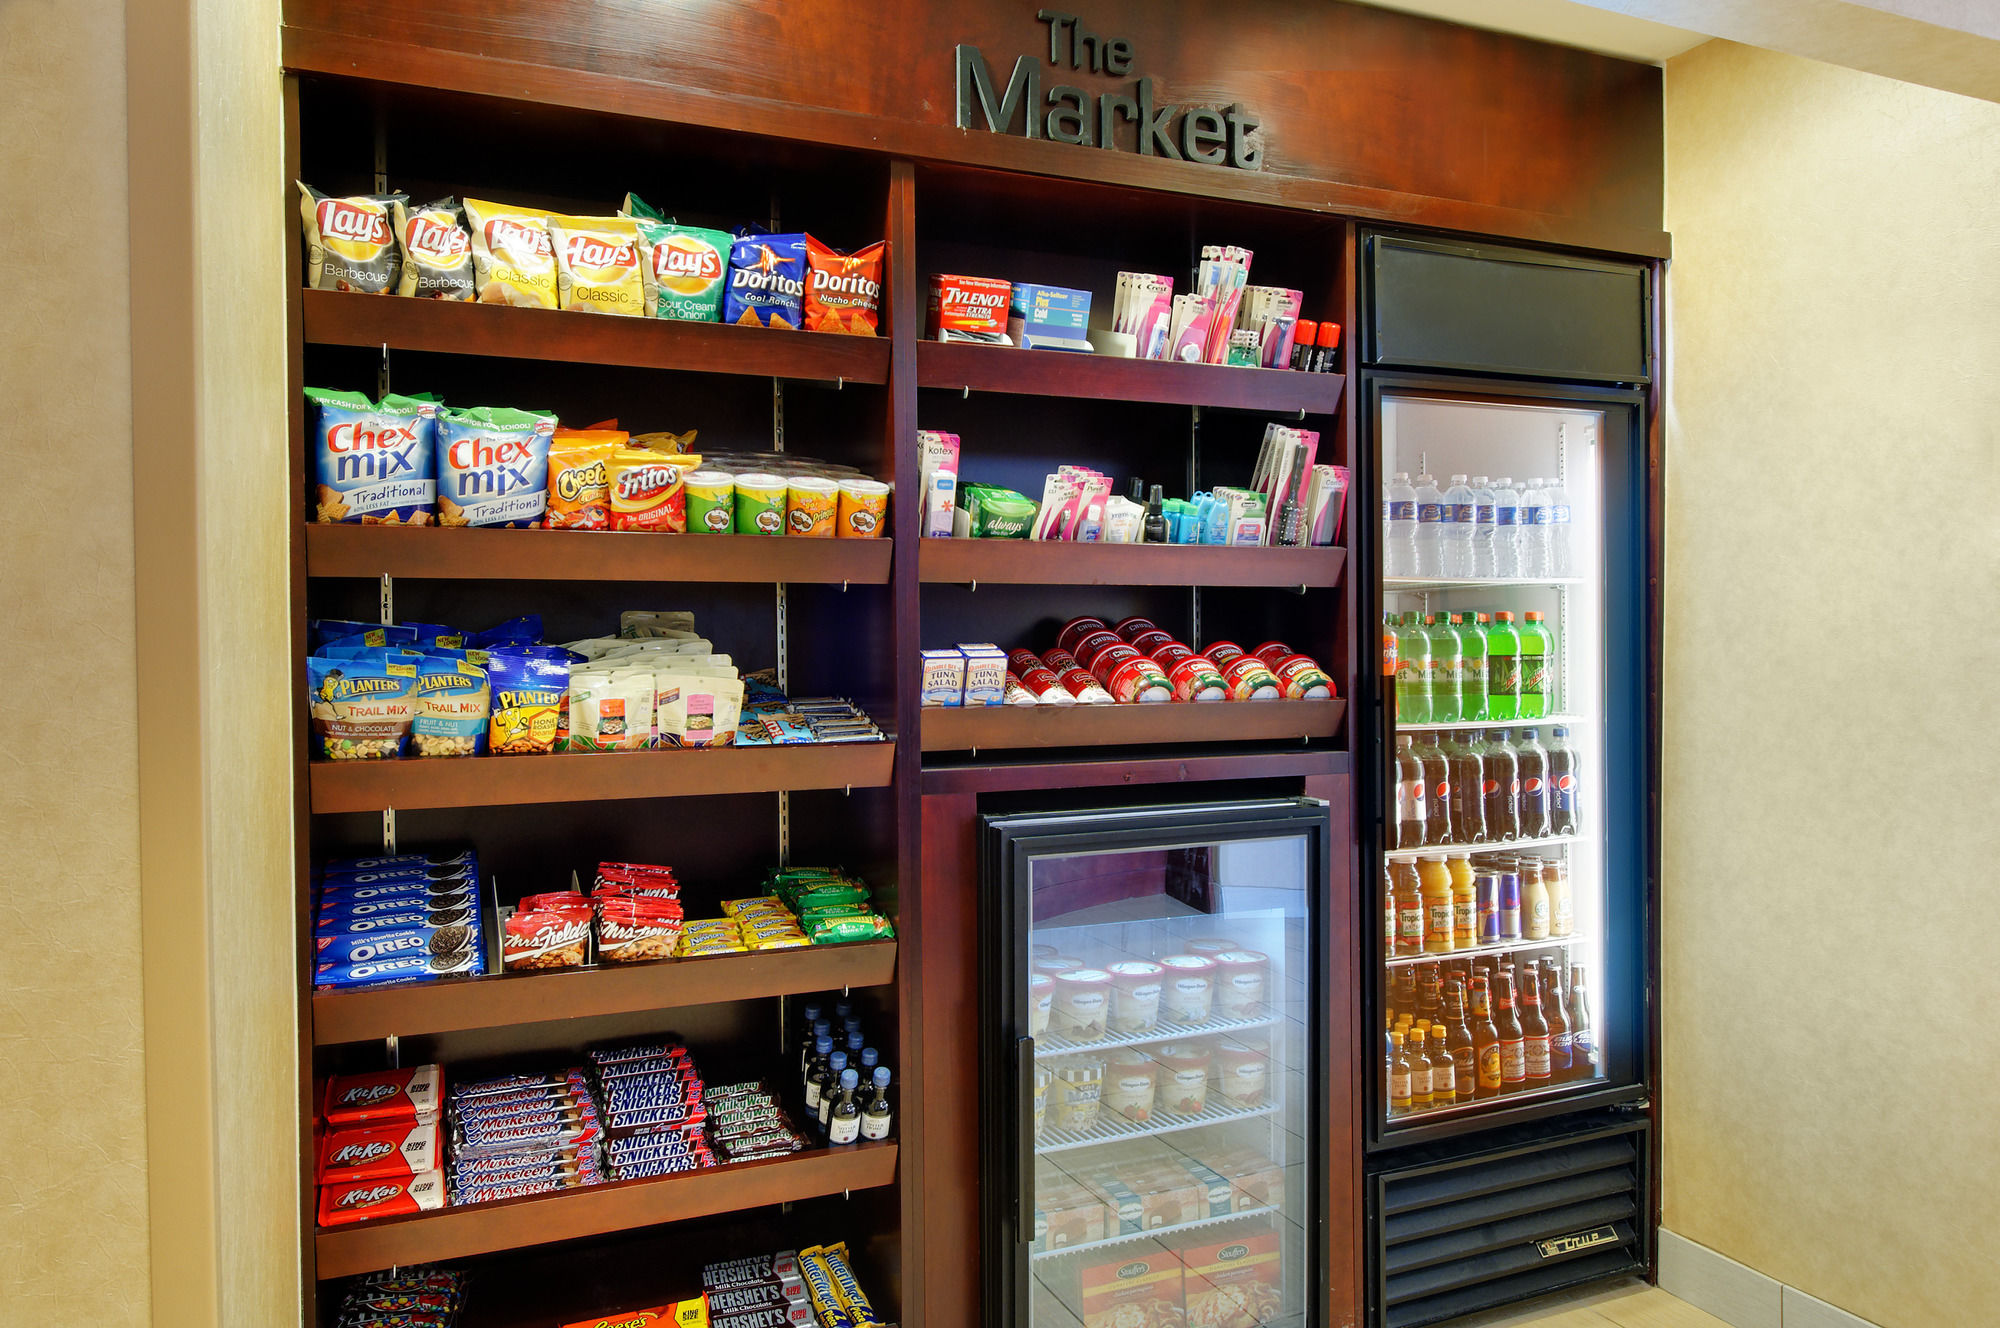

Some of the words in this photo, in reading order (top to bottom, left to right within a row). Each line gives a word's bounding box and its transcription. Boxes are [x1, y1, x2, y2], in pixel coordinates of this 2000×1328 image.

[1037, 8, 1134, 75] The
[956, 43, 1264, 172] Market
[657, 243, 718, 279] Lay's
[325, 264, 389, 283] Barbecue
[418, 276, 475, 289] Barbecue
[496, 269, 550, 288] Classic
[733, 268, 805, 297] Doritos
[813, 268, 880, 299] Doritos
[577, 287, 629, 303] Classic
[744, 292, 766, 303] Cool
[768, 295, 796, 309] Ranch
[820, 294, 850, 305] Nacho
[946, 287, 1005, 308] TYLENOL
[658, 298, 683, 311] Sour
[684, 301, 717, 313] Cream
[669, 308, 675, 319] &
[677, 307, 706, 320] Onion
[967, 306, 992, 315] EXTRA
[331, 399, 351, 408] CASH
[327, 411, 423, 453] Chex
[449, 435, 537, 470] Chex
[928, 445, 954, 457] Kotex
[337, 441, 417, 481] mix
[457, 458, 533, 497] mix
[617, 465, 679, 500] Fritos
[353, 482, 426, 504] Traditional
[474, 500, 540, 518] Traditional
[638, 504, 675, 522] ORIGINAL
[987, 516, 1024, 535] always
[418, 674, 472, 691] PLANTERS
[928, 679, 958, 688] SALAD
[931, 671, 956, 680] TUNA
[971, 679, 1000, 688] SALAD
[974, 671, 998, 680] TUNA
[341, 678, 401, 695] PLANTERS
[424, 702, 458, 713] TRAIL
[460, 702, 481, 713] MIX
[500, 690, 559, 709] PLANTER
[348, 706, 385, 717] TRAIL
[387, 705, 409, 716] MIX
[332, 724, 347, 732] NUT
[354, 724, 397, 733] CHOCOLATE
[419, 718, 437, 727] FRUIT
[354, 869, 423, 882] OREO
[354, 884, 425, 898] OREO
[352, 899, 424, 915] OREO
[737, 899, 769, 912] Newtons
[350, 915, 424, 931] OREO
[745, 909, 777, 921] Newtons
[753, 919, 787, 929] Newtons
[687, 921, 723, 934] Newtons
[757, 928, 792, 939] Newtons
[351, 938, 370, 946] Milk's
[370, 933, 395, 942] Favorite
[689, 933, 725, 946] Newtons
[349, 936, 425, 962] OREO
[349, 958, 425, 978] OREO
[605, 1060, 672, 1078] SNICKERS
[471, 1075, 547, 1093] Musketeers
[705, 1085, 736, 1097] Milky
[735, 1081, 759, 1092] Way
[472, 1088, 548, 1107] Musketeers
[610, 1093, 680, 1113] SNICKERS
[714, 1099, 747, 1115] Milky
[746, 1094, 771, 1107] Way
[478, 1100, 555, 1119] Musketeers
[614, 1104, 686, 1127] SNICKERS
[721, 1112, 753, 1125] Milky
[751, 1107, 778, 1119] Way
[482, 1111, 560, 1131] Musketeers
[723, 1124, 755, 1135] Milky
[483, 1123, 563, 1142] Musketeers
[612, 1130, 683, 1152] SNICKERS
[736, 1135, 768, 1148] Milky
[473, 1153, 555, 1171] Musketeers
[616, 1141, 688, 1166] SNICKERS
[473, 1165, 556, 1186] Musketeers
[474, 1180, 557, 1200] Musketeers
[703, 1262, 772, 1287] HERSHEY'S
[800, 1252, 841, 1309] Butterfinger
[823, 1248, 867, 1305] Butterfinger
[715, 1282, 731, 1291] Milk
[731, 1278, 765, 1289] Chocolate
[709, 1285, 781, 1311] HERSHEY'S
[722, 1306, 739, 1315] Milk
[739, 1301, 773, 1312] Chocolate
[713, 1308, 786, 1328] HERSHEY'S
